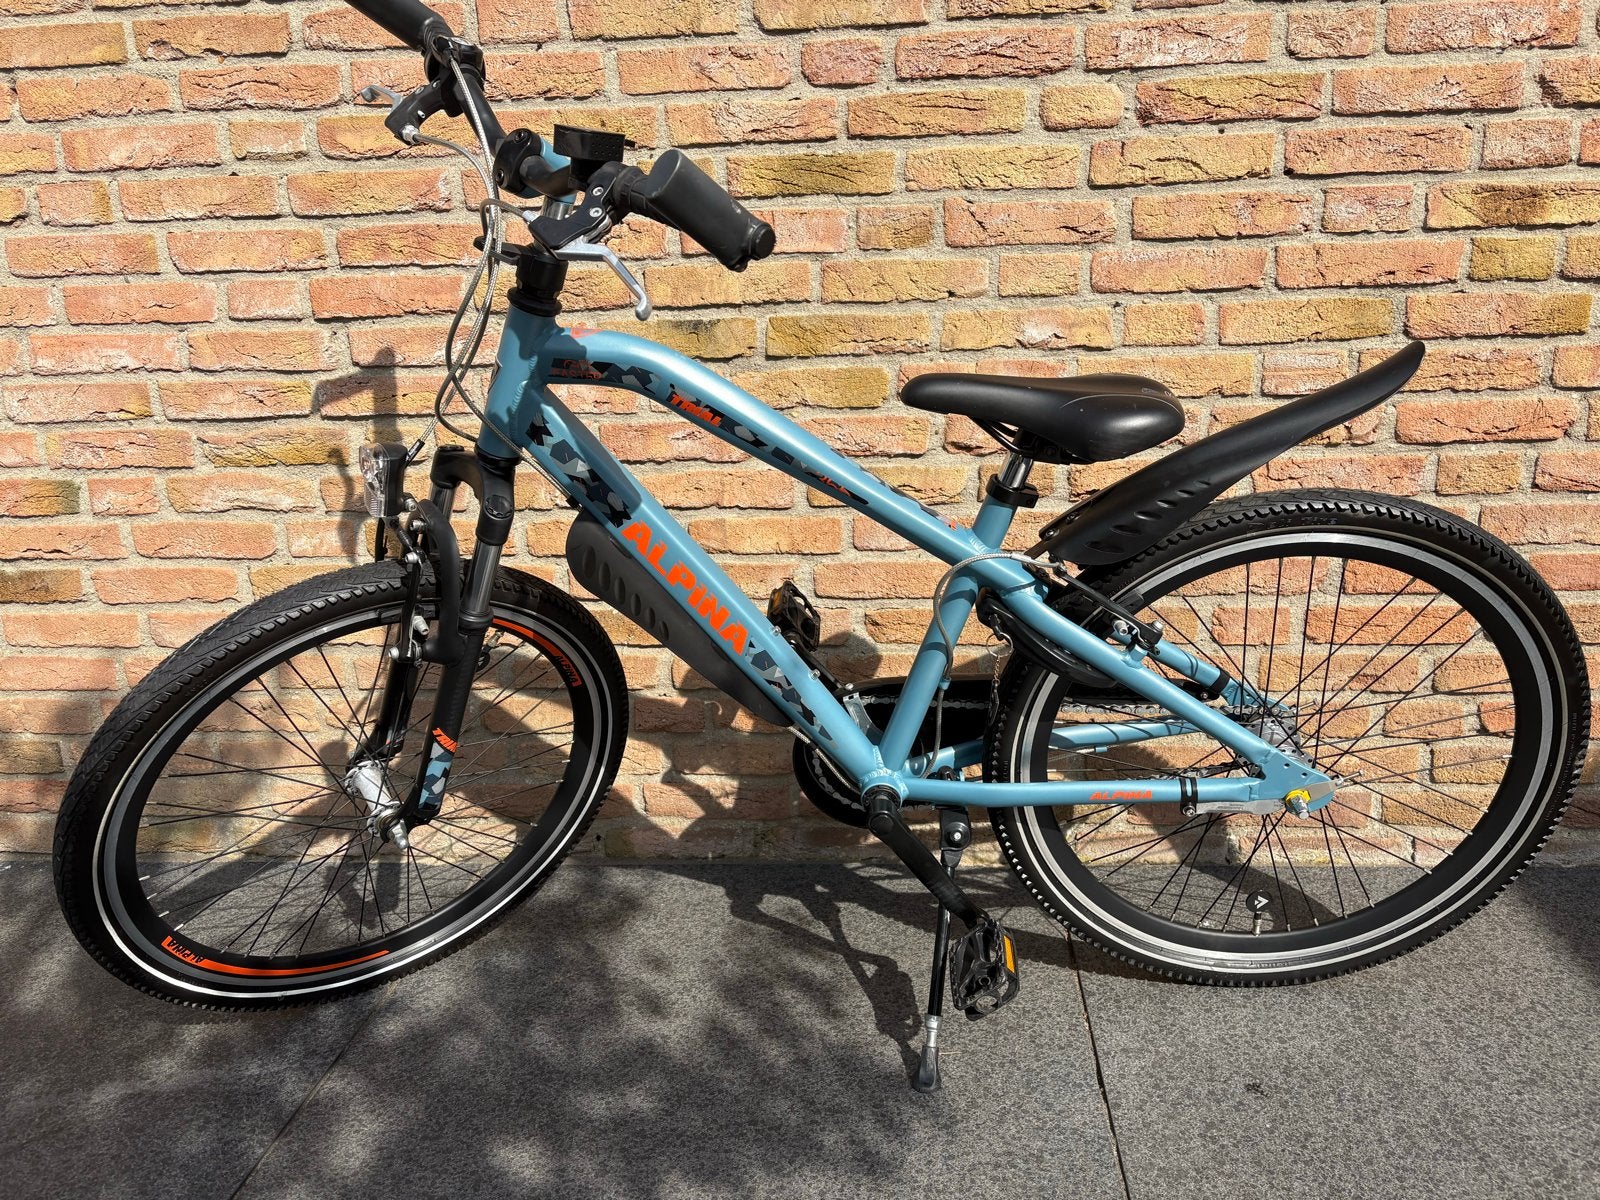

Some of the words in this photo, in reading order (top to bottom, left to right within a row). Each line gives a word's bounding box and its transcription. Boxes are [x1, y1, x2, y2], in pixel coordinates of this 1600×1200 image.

[671, 393, 722, 427] TRIAL
[621, 520, 749, 656] ALPINA
[1089, 789, 1153, 801] ALPINA
[166, 938, 206, 964] ALPINA
